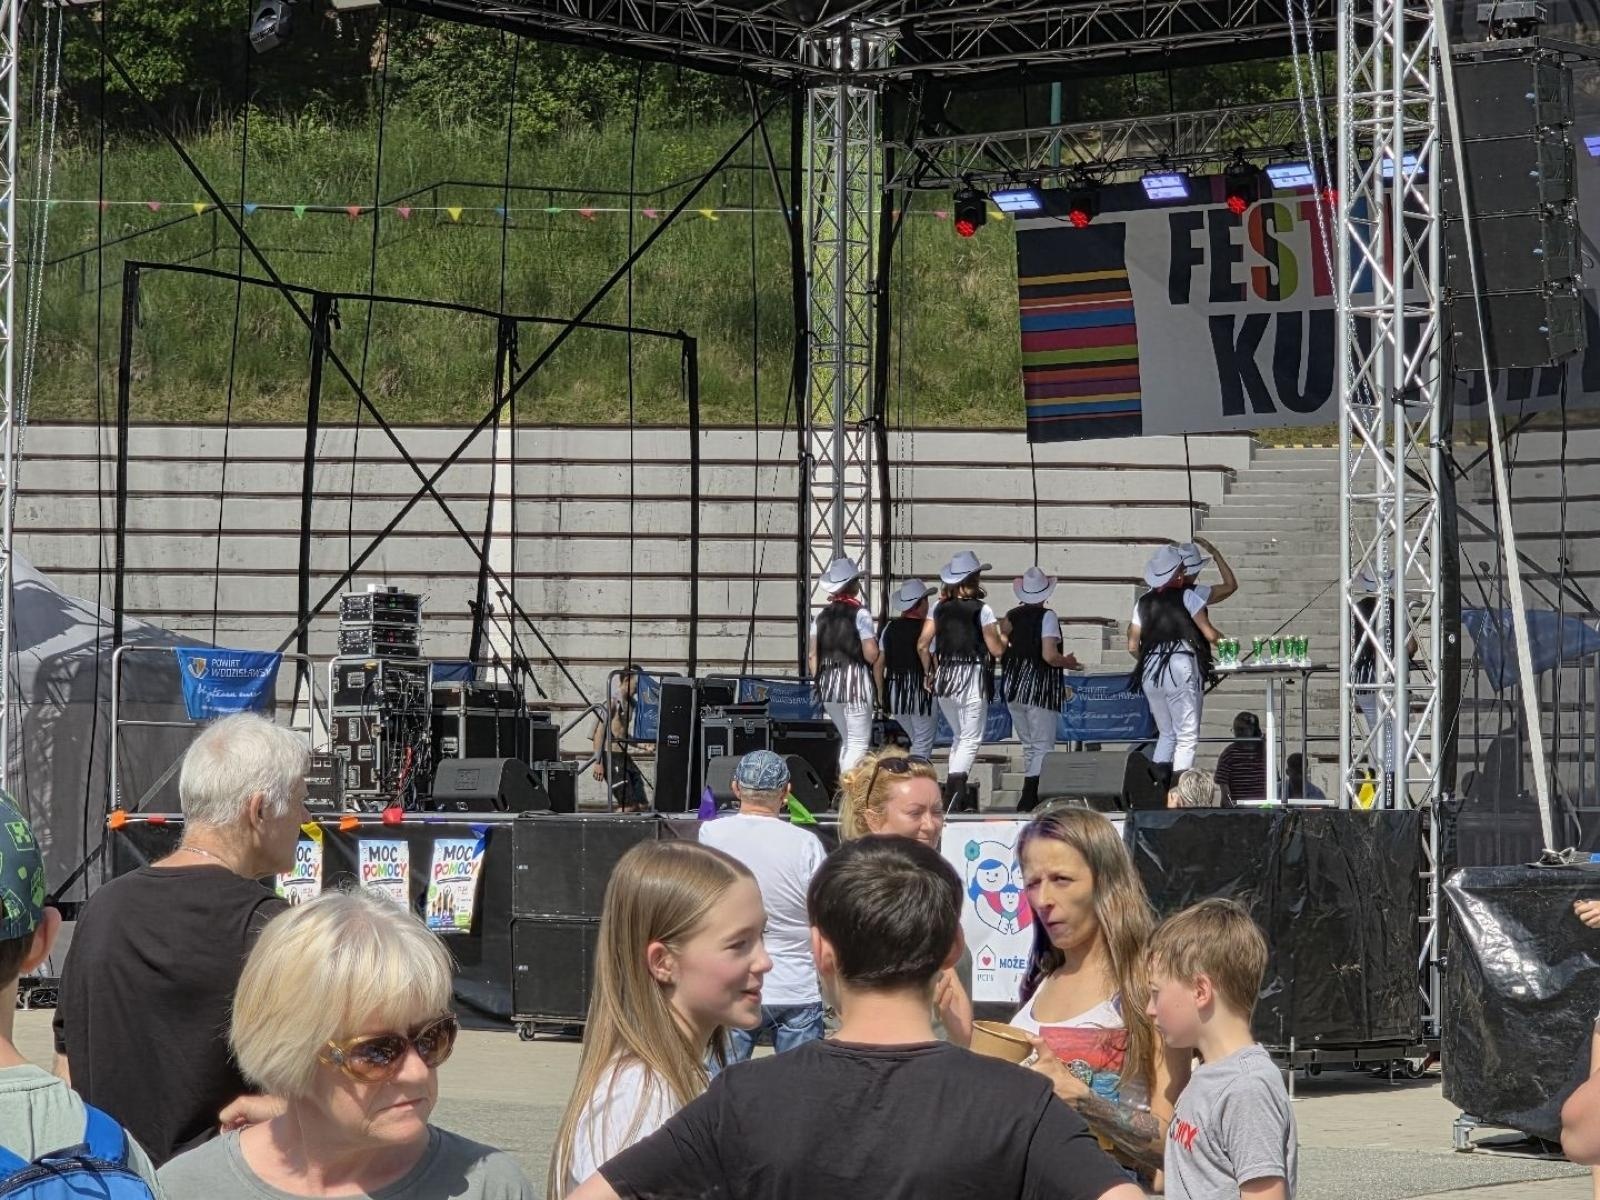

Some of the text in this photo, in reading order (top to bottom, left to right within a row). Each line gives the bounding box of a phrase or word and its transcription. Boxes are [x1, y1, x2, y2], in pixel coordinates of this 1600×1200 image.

[296, 846, 312, 863] OC
[368, 846, 398, 863] MOC
[443, 845, 473, 862] MOC
[363, 863, 408, 881] POMOCY
[434, 861, 478, 880] POMOCY
[999, 955, 1029, 969] MOŻE
